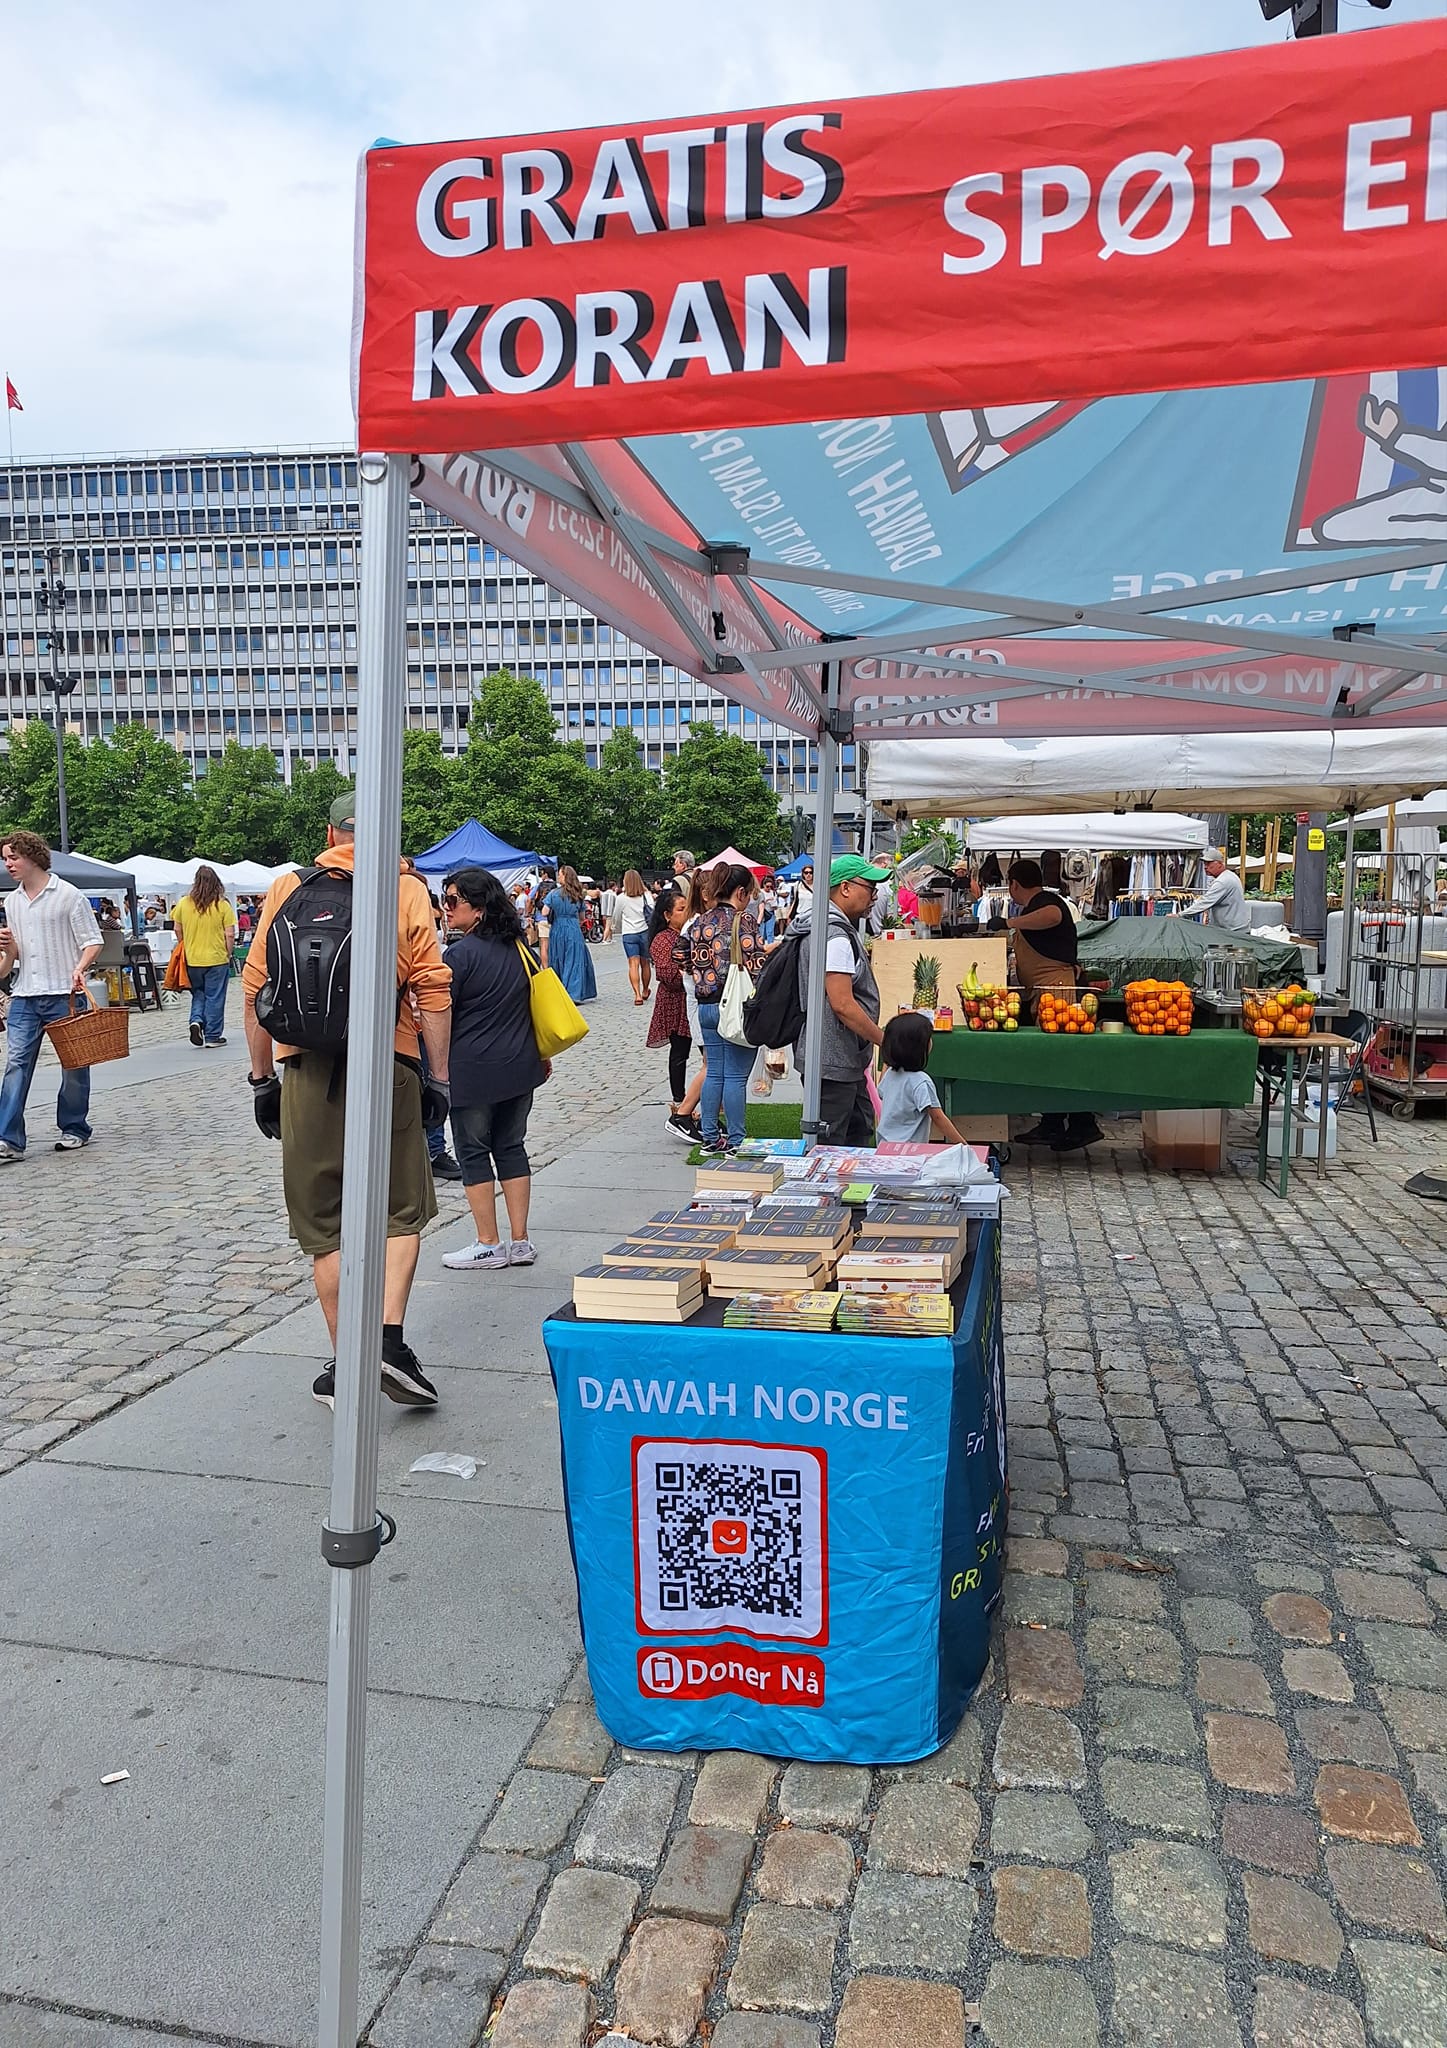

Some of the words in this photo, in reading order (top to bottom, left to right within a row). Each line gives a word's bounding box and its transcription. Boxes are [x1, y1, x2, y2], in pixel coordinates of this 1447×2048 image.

[415, 112, 845, 258] GRATIS
[942, 138, 1293, 276] SPØR
[1343, 110, 1447, 232] E
[411, 265, 849, 402] KORAN
[690, 948, 715, 962] DIOR
[746, 956, 767, 971] DIO
[577, 1376, 738, 1417] DAWAH
[753, 1384, 910, 1431] NORGE
[686, 1658, 771, 1691] Doner
[781, 1665, 820, 1695] Nå
